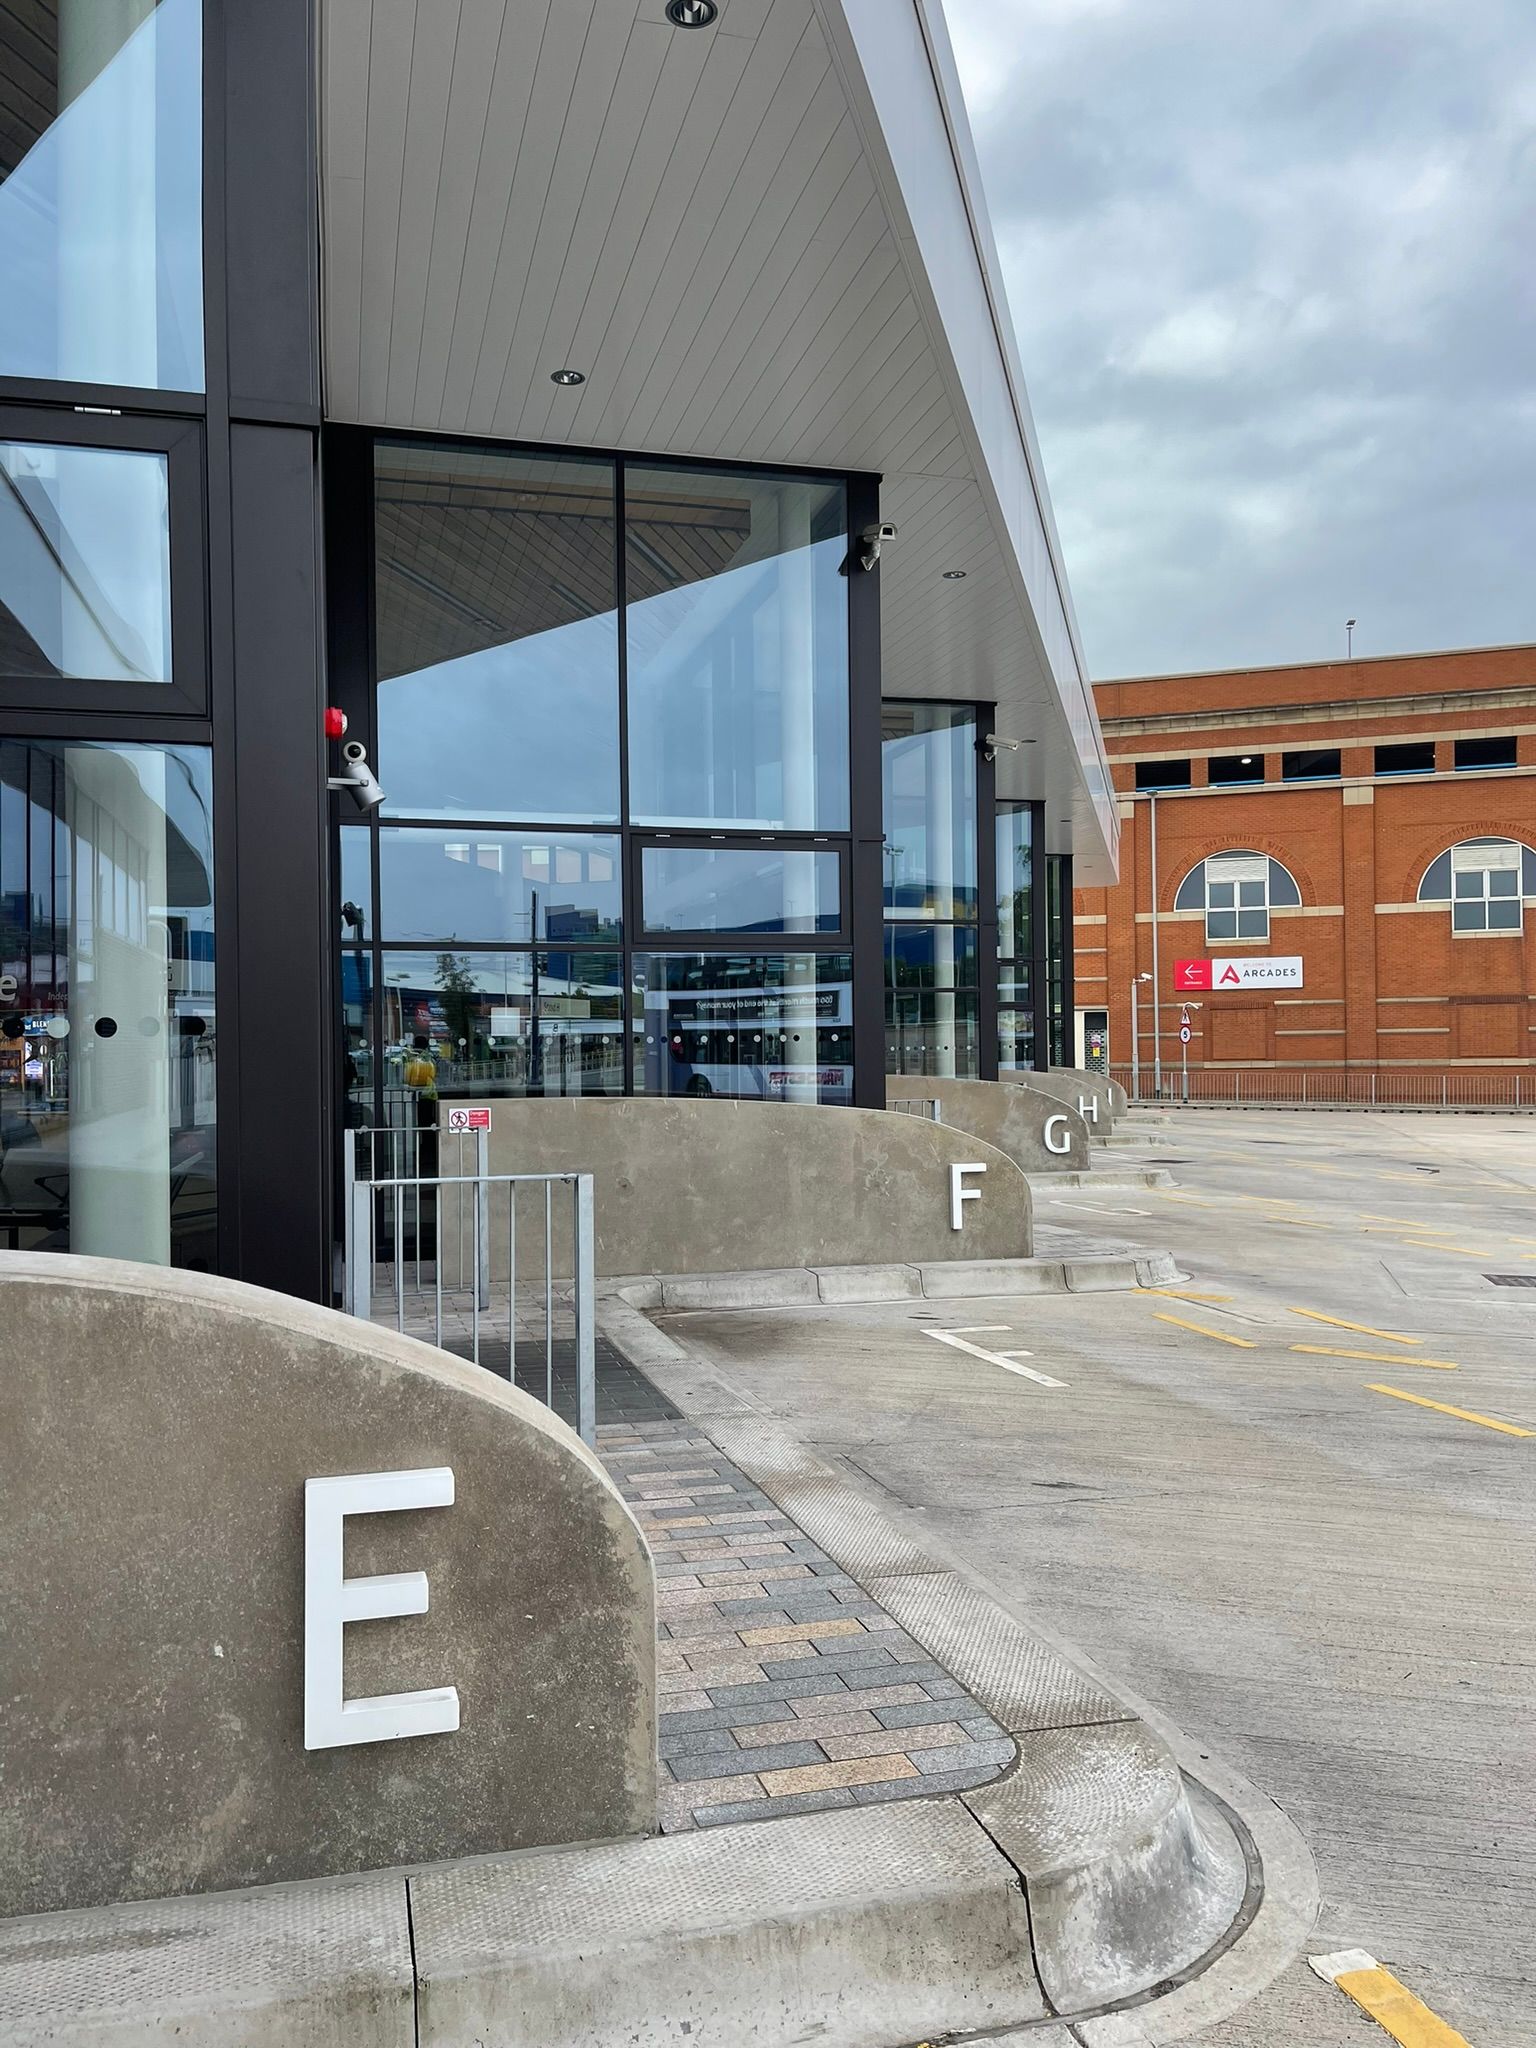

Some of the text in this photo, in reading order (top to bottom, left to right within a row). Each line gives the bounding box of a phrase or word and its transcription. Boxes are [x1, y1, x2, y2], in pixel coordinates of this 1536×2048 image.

[1243, 968, 1297, 977] ARCADES
[1182, 1028, 1188, 1039] 5
[1078, 1095, 1098, 1123] H
[1044, 1114, 1071, 1154] G
[951, 1162, 987, 1230] F
[304, 1466, 460, 1750] E
